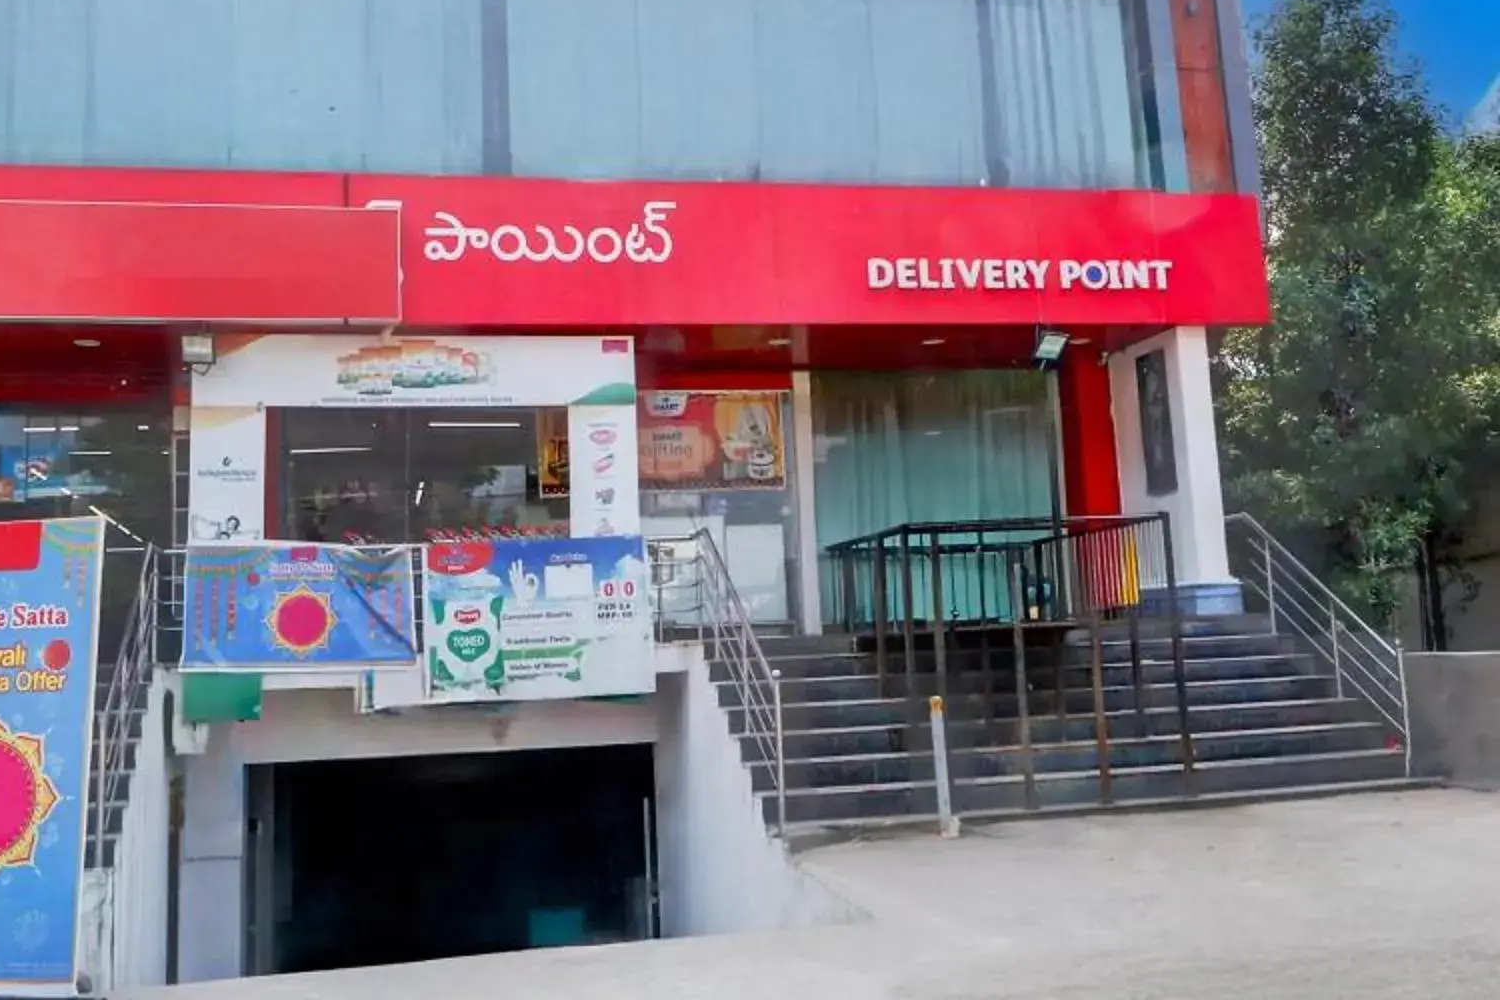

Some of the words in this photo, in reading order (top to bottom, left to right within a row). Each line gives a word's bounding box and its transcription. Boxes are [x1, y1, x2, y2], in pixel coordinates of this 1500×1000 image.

[423, 200, 677, 264] పాయింట్
[867, 257, 1050, 290] DELIVERY
[1059, 259, 1173, 291] POINT
[11, 601, 68, 630] Satta
[15, 671, 67, 693] Offer
